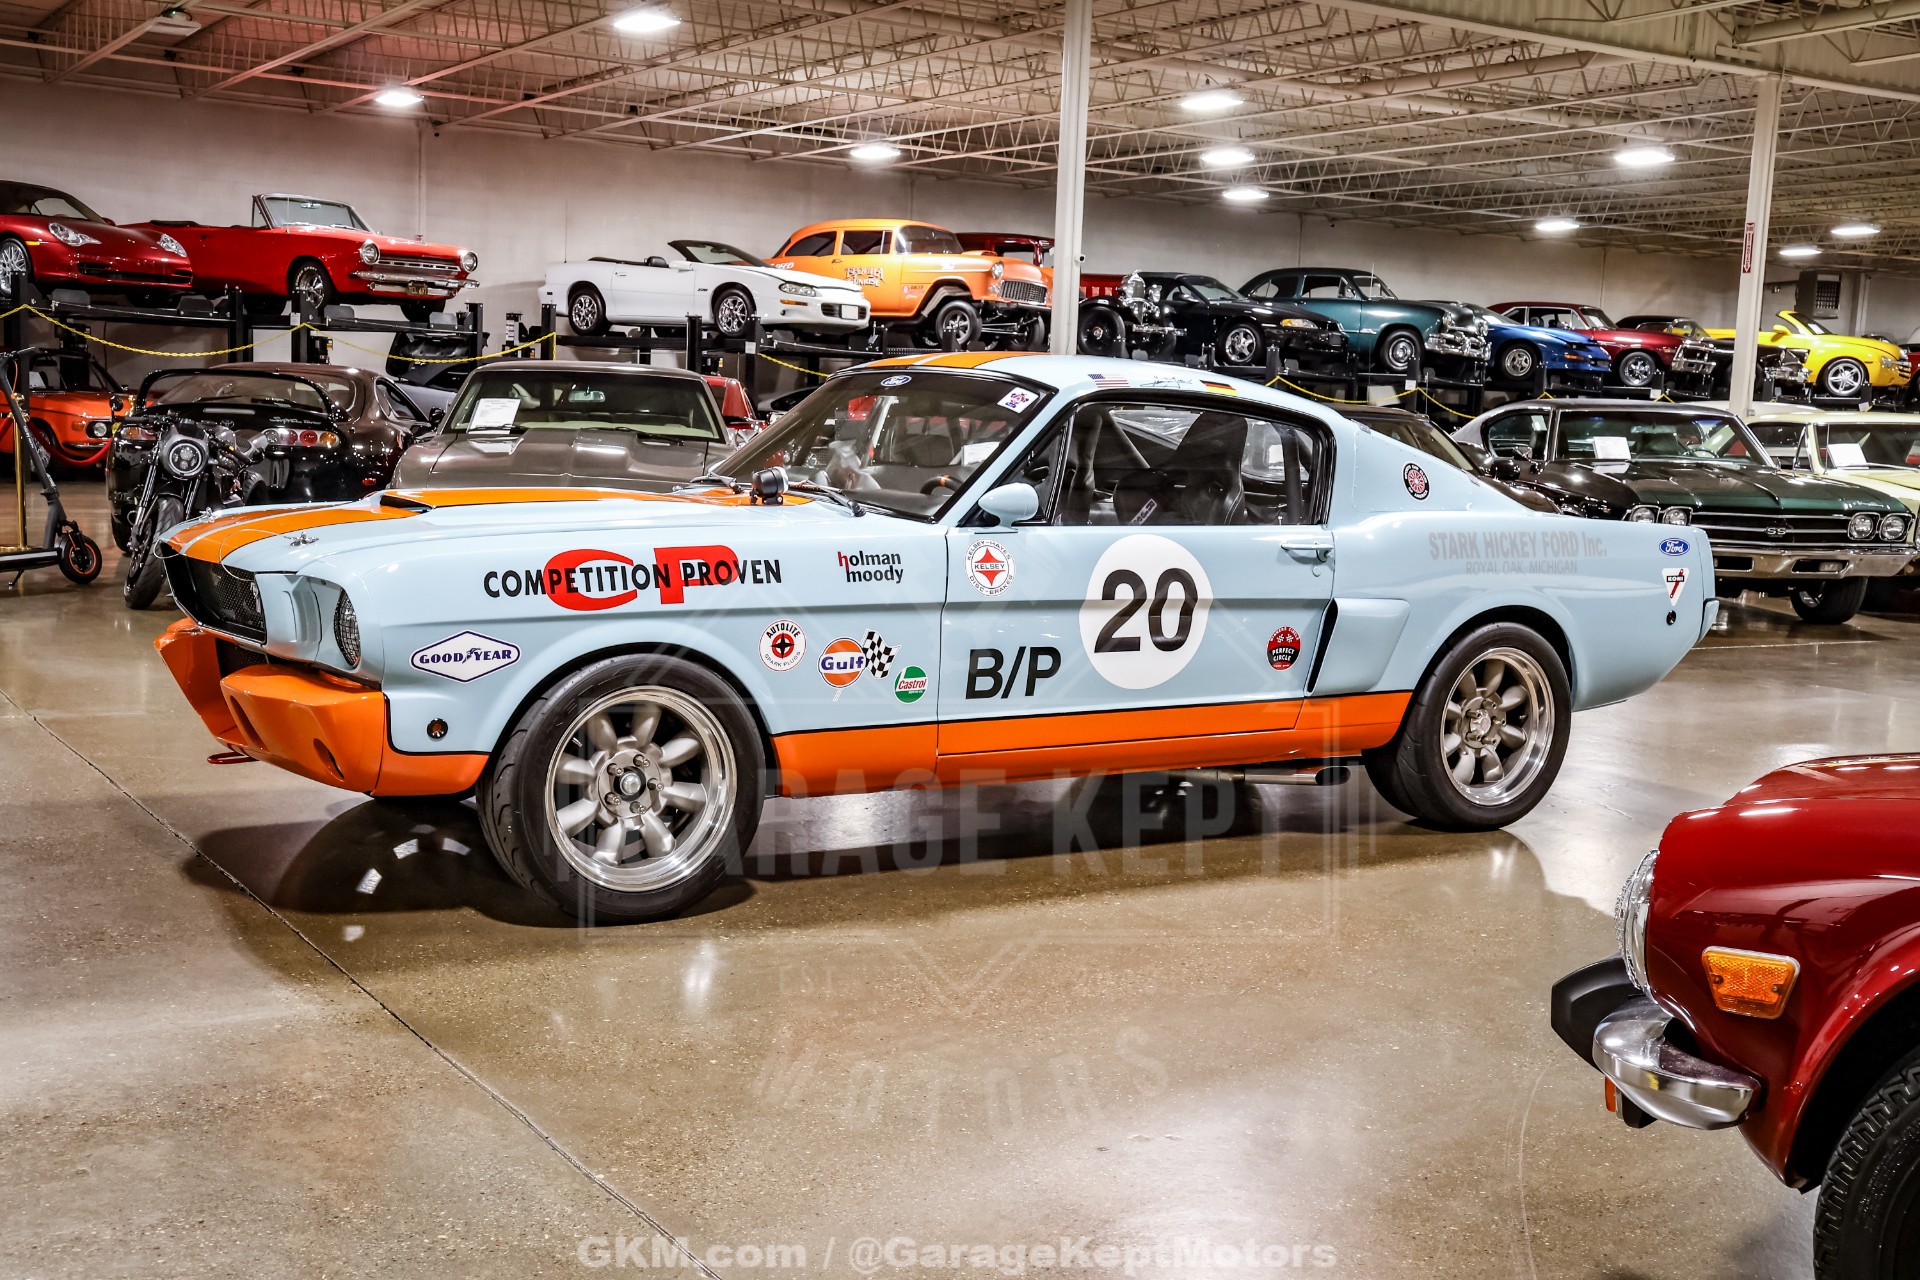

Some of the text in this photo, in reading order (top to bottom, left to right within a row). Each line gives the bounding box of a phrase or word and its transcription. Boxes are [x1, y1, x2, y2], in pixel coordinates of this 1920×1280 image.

[1766, 527, 1787, 535] SS
[1429, 531, 1608, 560] STARK HICKEY FORD Inc.
[1665, 540, 1684, 553] Ford
[837, 550, 902, 569] holman
[1466, 559, 1577, 576] ROYAL OAK, MICHIGAN
[483, 559, 782, 598] COMPETITION PROVEN
[846, 565, 904, 584] moody
[1094, 567, 1198, 654] 20
[766, 622, 801, 639] AUTOLITE
[765, 651, 801, 668] SPARK PLUGS
[1272, 647, 1295, 655] PERFECT
[821, 656, 864, 671] Gulf
[965, 646, 1062, 699] B/P
[898, 678, 927, 691] Castrol
